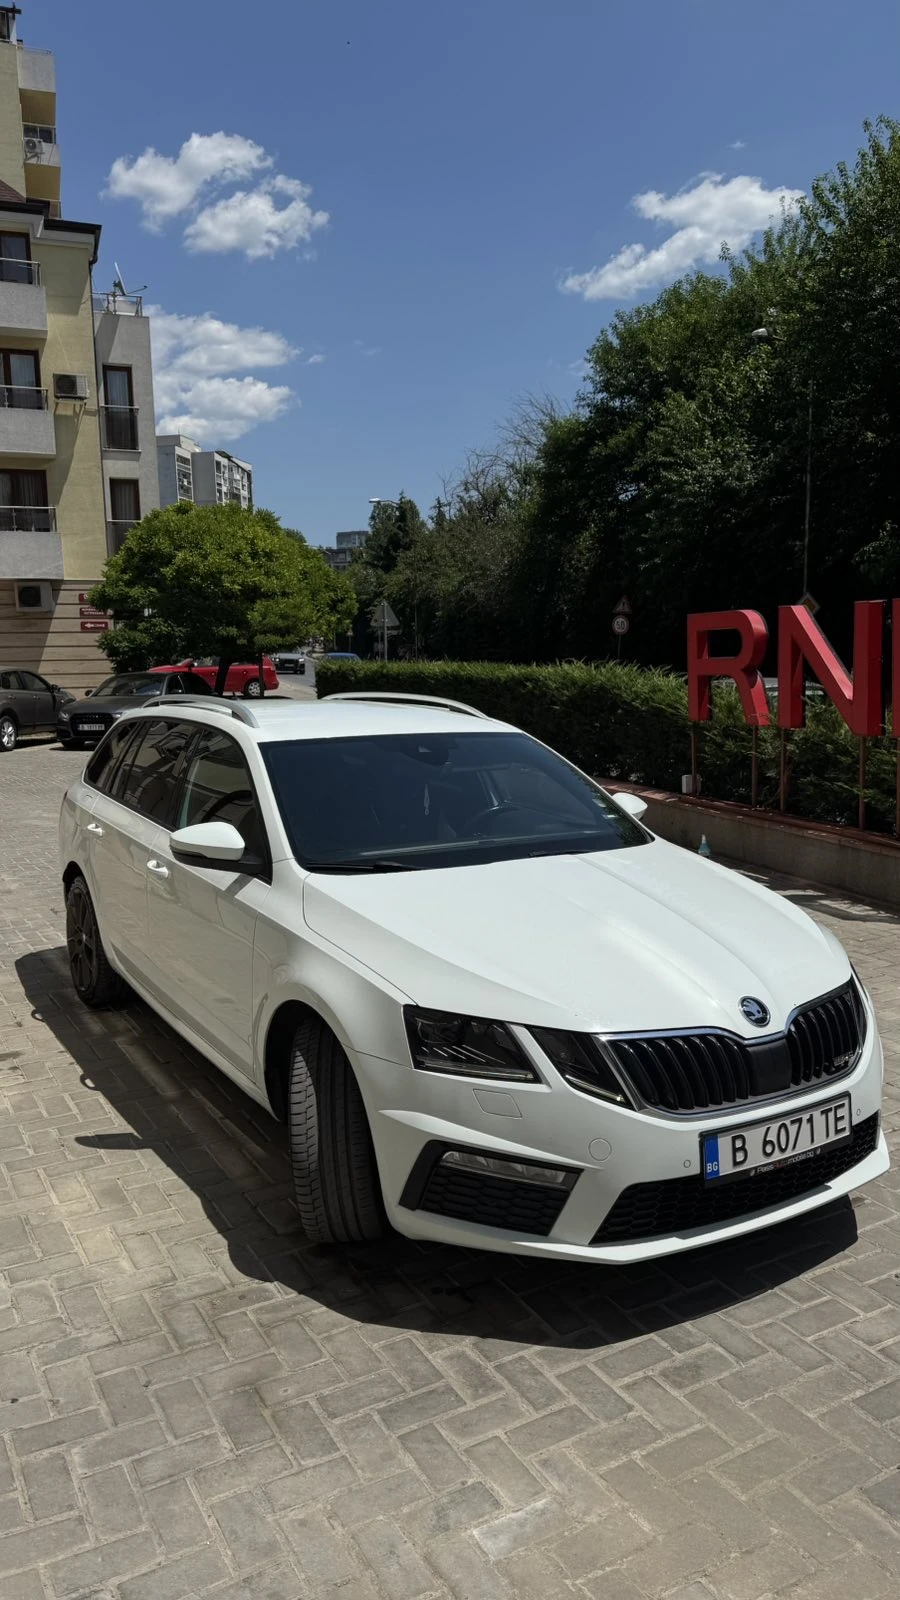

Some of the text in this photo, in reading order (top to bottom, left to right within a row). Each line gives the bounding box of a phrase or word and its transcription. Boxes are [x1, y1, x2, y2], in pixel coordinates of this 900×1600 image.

[687, 598, 900, 736] RN
[706, 1161, 719, 1173] BG
[731, 1102, 847, 1167] B 6071 TE
